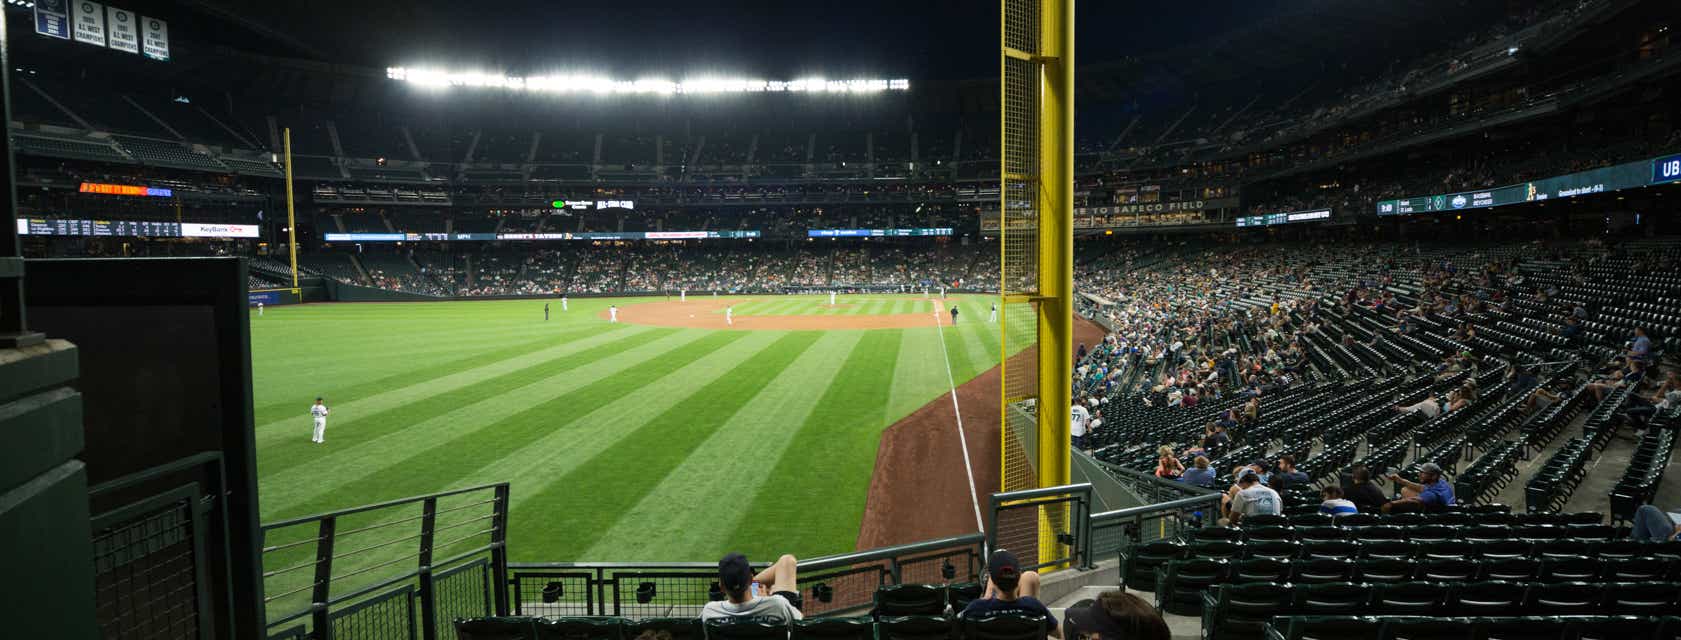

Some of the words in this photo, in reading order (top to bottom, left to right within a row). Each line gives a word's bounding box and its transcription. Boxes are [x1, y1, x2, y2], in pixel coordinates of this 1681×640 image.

[76, 32, 104, 43] CHAMPIONS
[111, 39, 137, 50] CHAMPIONS
[145, 46, 168, 56] CHAMPIONS
[1114, 203, 1163, 213] SAFECO
[1169, 200, 1204, 211] FIELD
